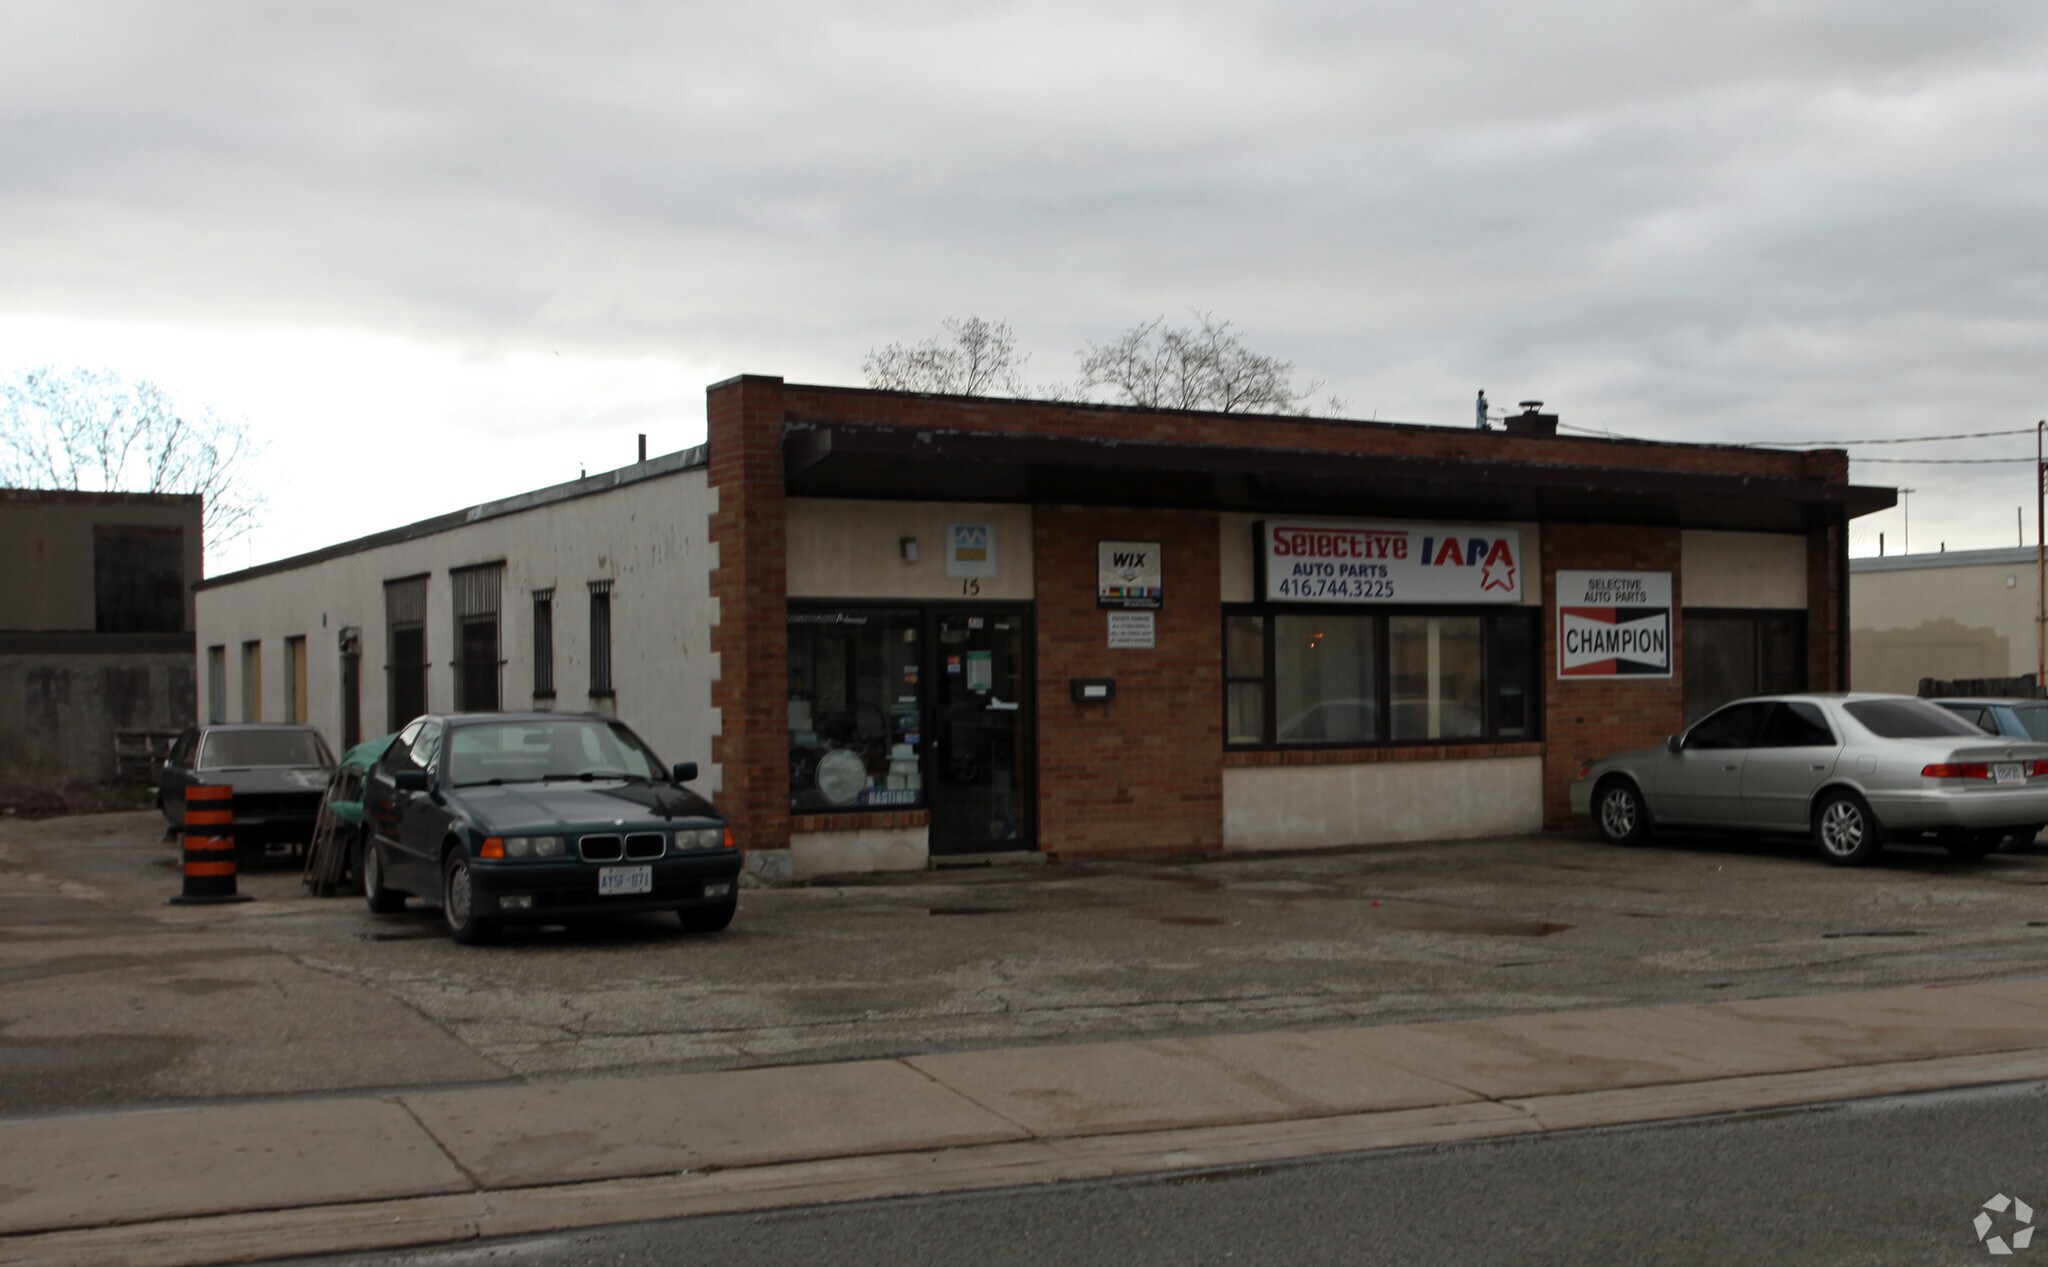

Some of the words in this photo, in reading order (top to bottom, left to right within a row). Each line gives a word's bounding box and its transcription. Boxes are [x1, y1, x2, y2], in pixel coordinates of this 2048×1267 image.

[1273, 526, 1409, 560] Selective
[1421, 536, 1515, 567] IAPA
[1113, 552, 1146, 567] WIX
[1292, 562, 1334, 577] AUTO
[1339, 563, 1388, 578] PARTS
[963, 577, 980, 596] 15
[1279, 578, 1394, 598] 416.744.3225
[1588, 578, 1642, 591] SELECTIVE
[1584, 591, 1611, 603] AUTO
[1615, 591, 1647, 603] PARTS
[1566, 628, 1665, 654] CHAMPION
[868, 790, 915, 806] HASTINGS
